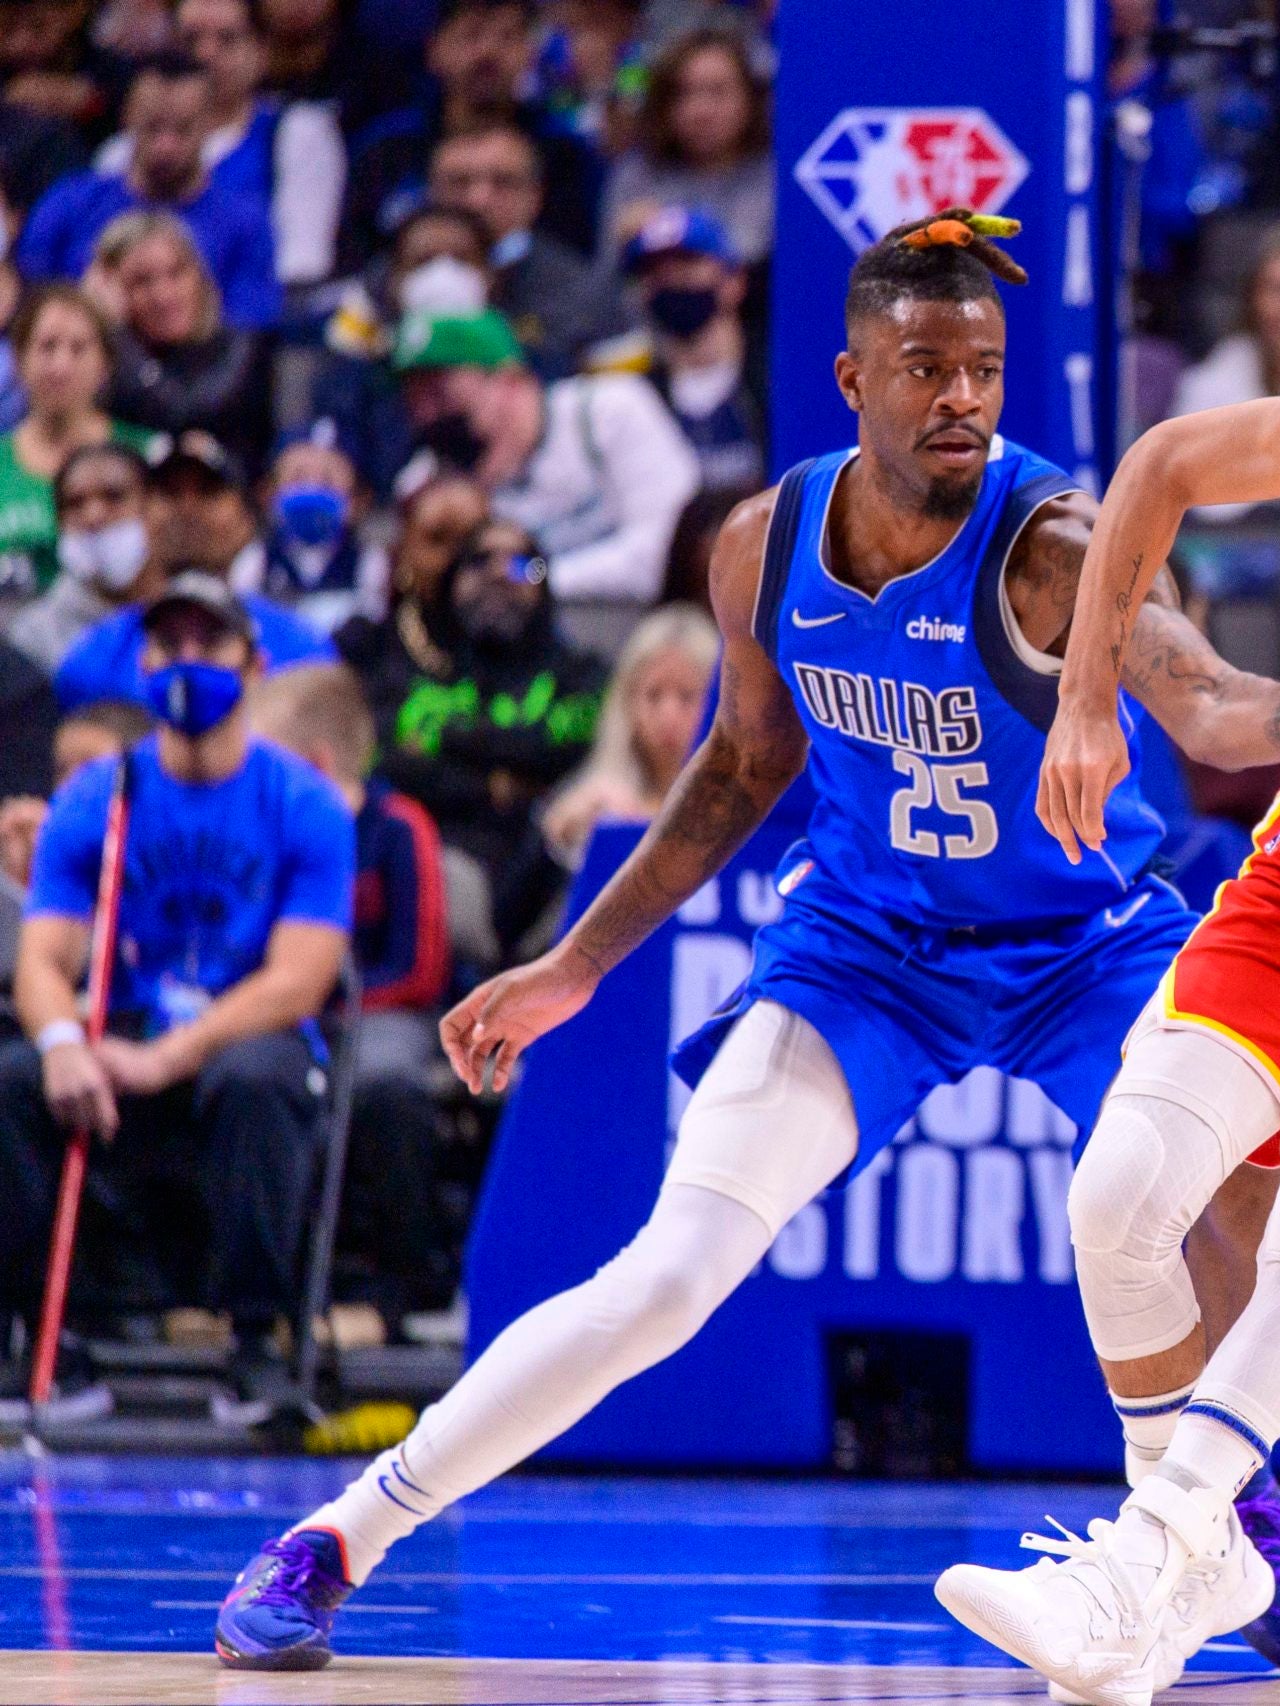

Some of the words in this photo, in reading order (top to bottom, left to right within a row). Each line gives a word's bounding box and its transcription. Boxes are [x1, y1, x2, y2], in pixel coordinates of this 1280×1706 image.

[906, 614, 966, 644] chime
[793, 661, 983, 757] DALLAS
[890, 749, 999, 860] 25
